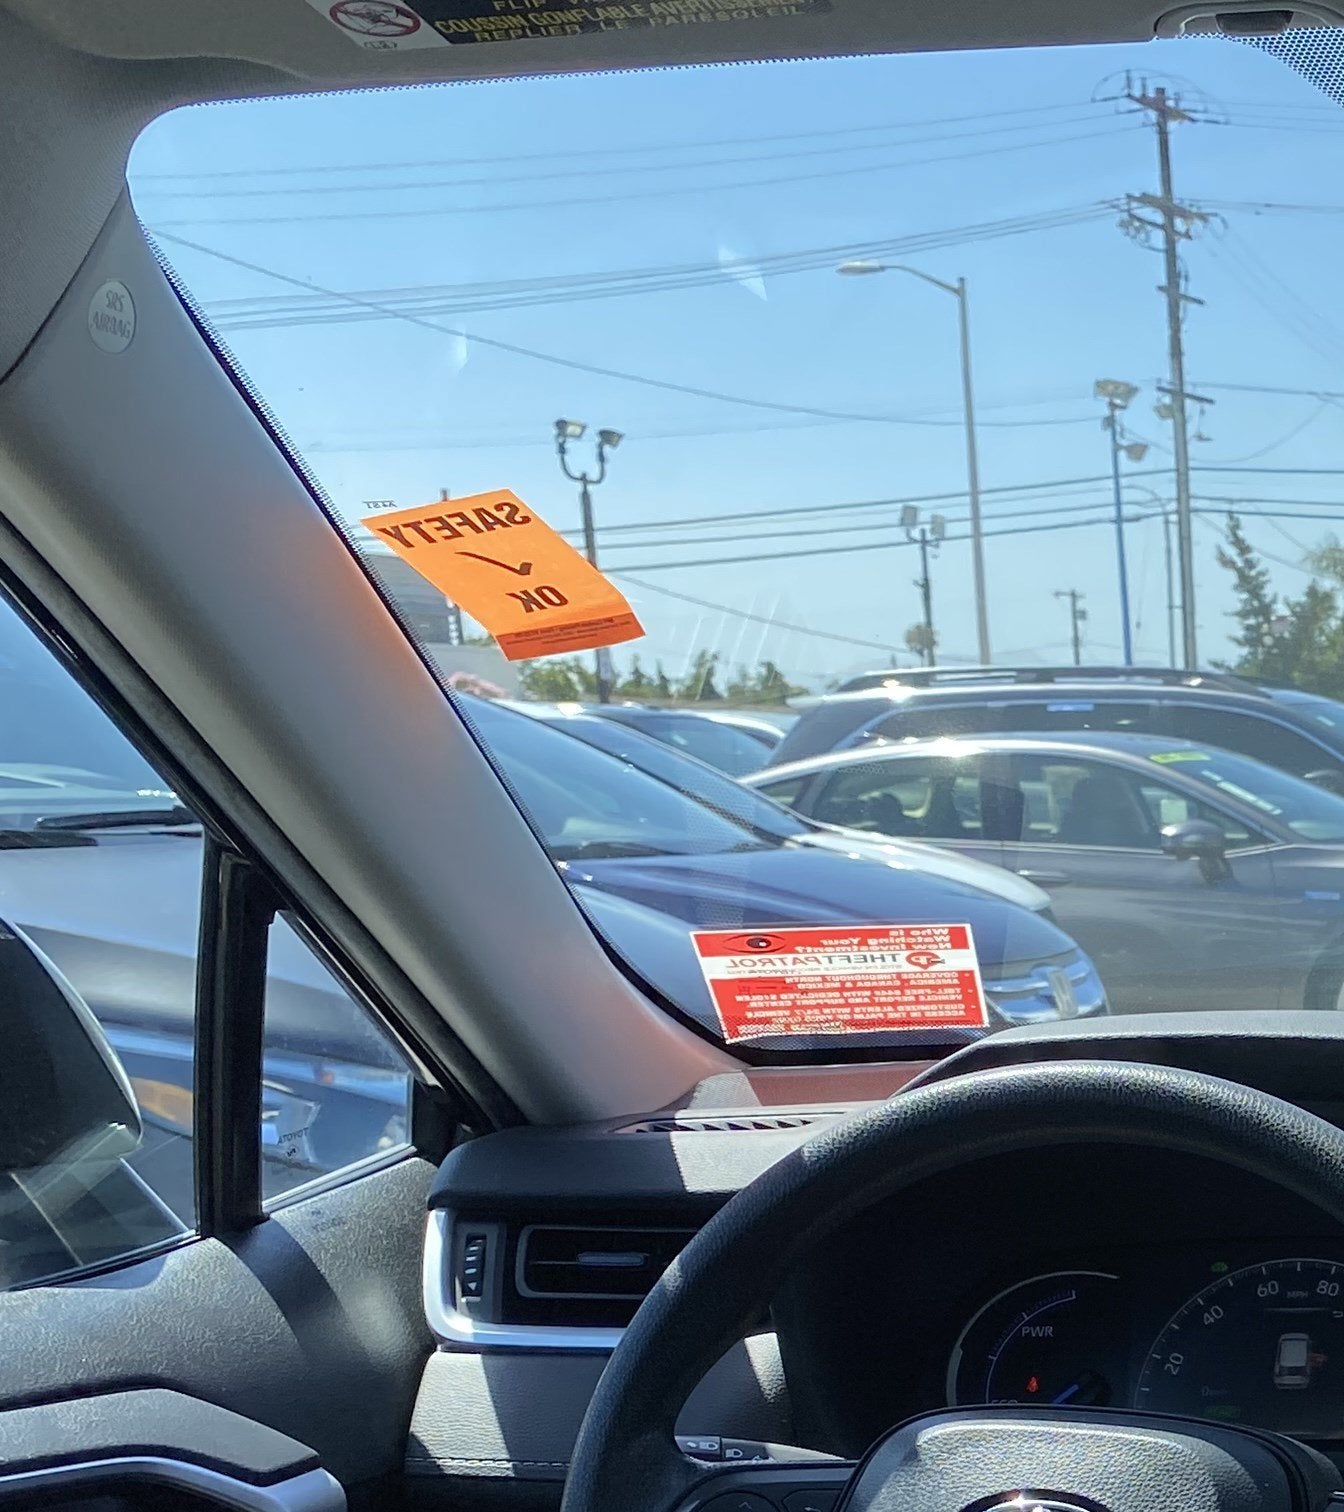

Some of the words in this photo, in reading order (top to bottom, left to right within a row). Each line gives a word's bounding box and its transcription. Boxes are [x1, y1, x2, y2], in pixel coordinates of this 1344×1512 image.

[434, 14, 527, 34] COUSSIN
[528, 3, 646, 28] GONFLABLE
[1257, 1280, 1279, 1298] 60
[1287, 1290, 1309, 1298] MPH
[1317, 1280, 1340, 1297] 80
[1202, 1305, 1225, 1326] 40
[1022, 1326, 1054, 1338] PWR
[1164, 1352, 1184, 1376] 20
